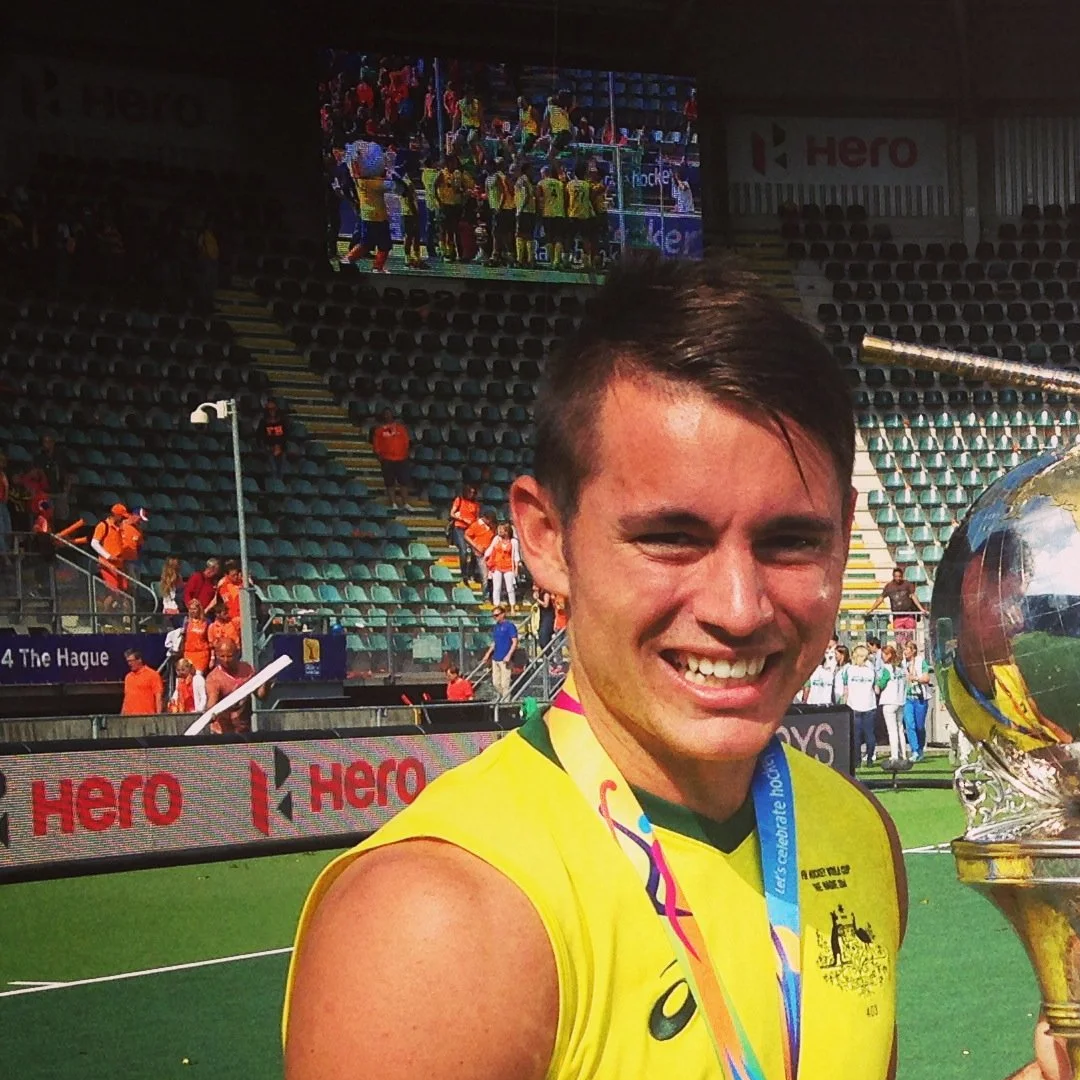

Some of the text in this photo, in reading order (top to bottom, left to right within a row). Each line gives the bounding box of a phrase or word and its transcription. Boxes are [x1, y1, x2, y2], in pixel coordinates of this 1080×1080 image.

[805, 136, 918, 168] Hero
[631, 166, 673, 189] hocke
[1, 648, 109, 670] 4 The Hague
[310, 757, 426, 812] Hero
[32, 771, 182, 836] Hero
[771, 800, 789, 865] celebrate
[774, 867, 787, 895] Let's
